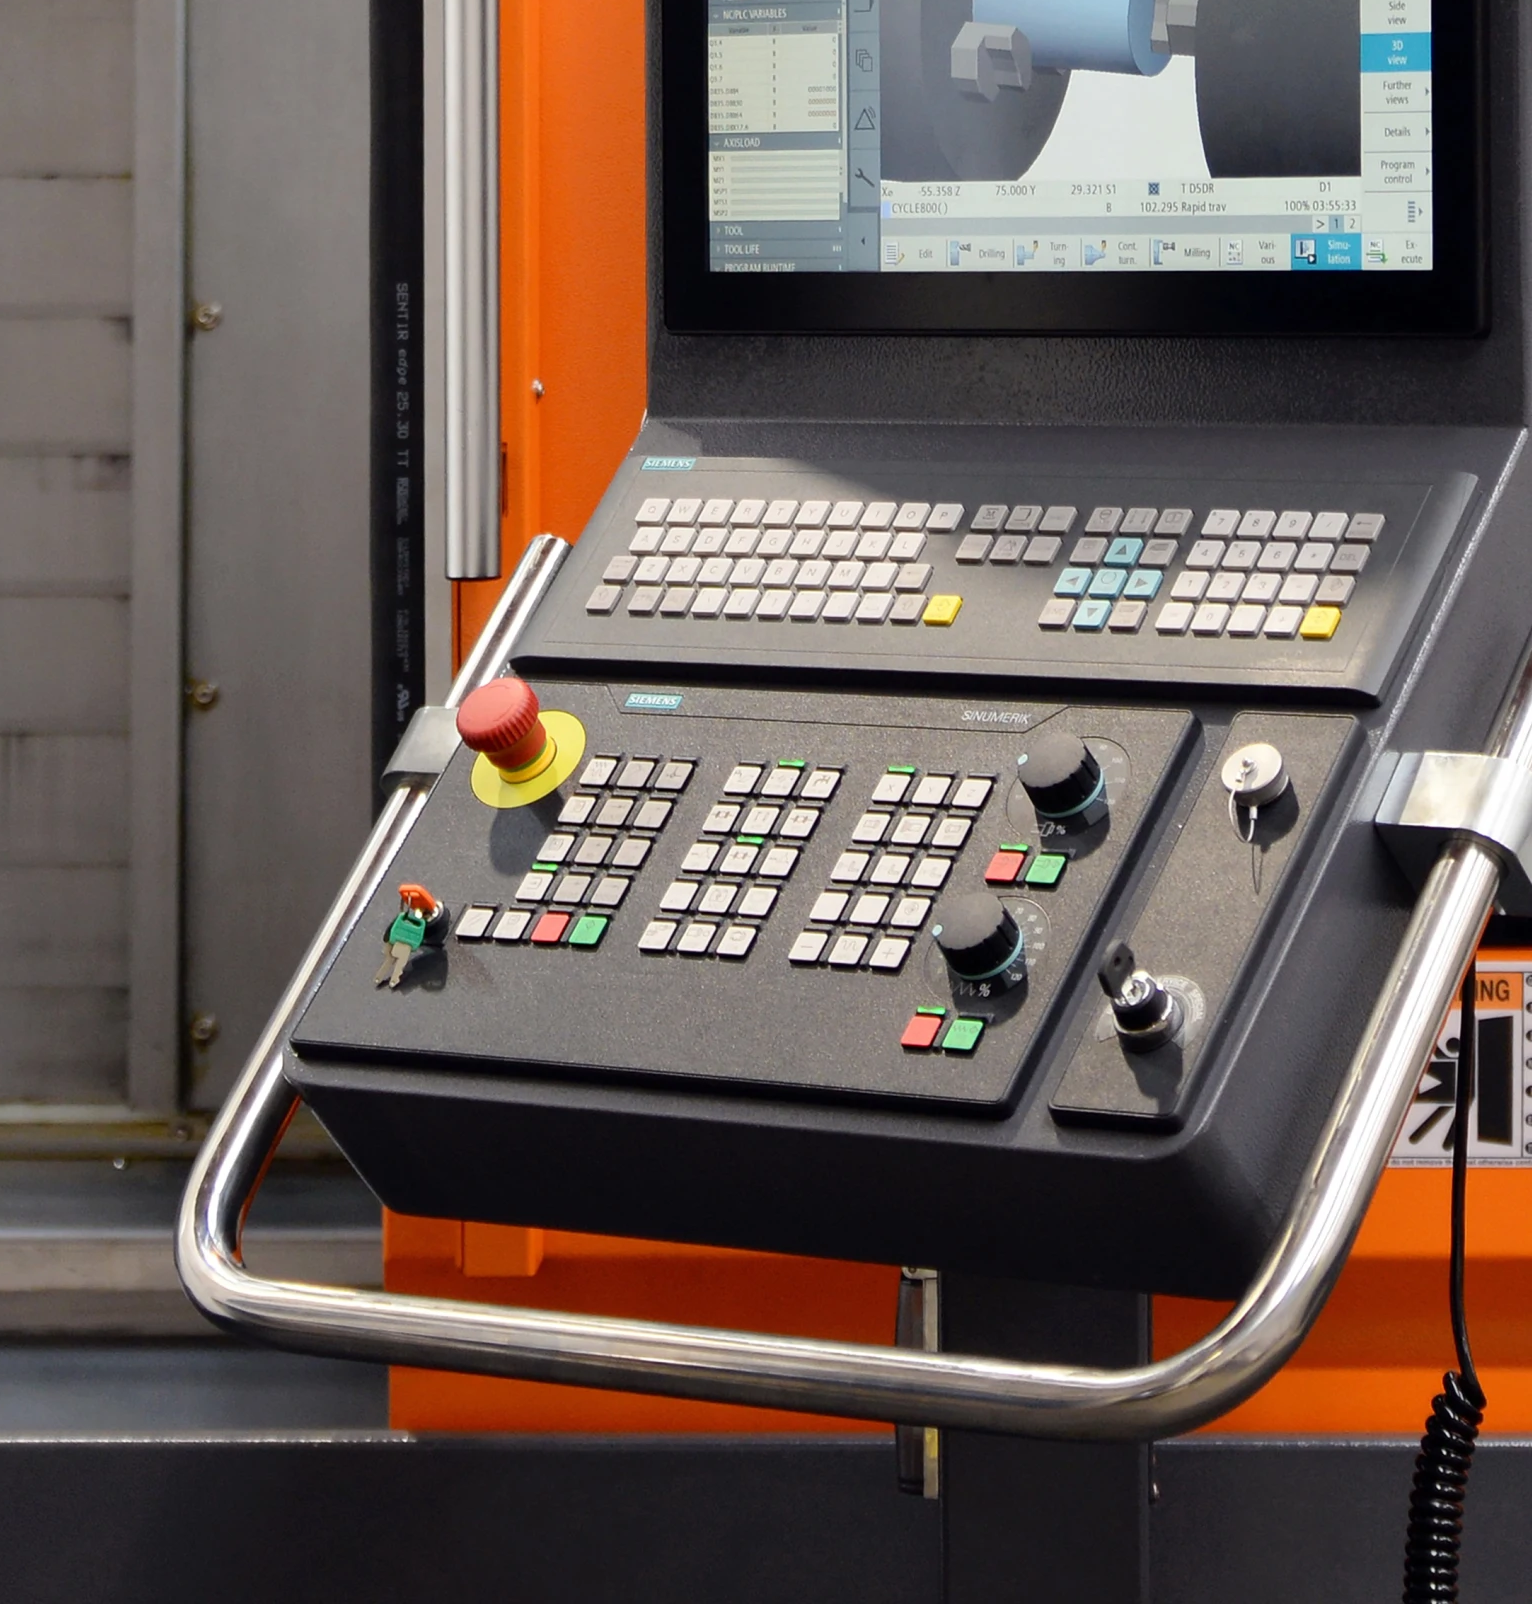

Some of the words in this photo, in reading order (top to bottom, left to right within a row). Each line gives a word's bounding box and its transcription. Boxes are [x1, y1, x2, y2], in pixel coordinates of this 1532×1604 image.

[1389, 1, 1406, 11] Side
[723, 9, 749, 20] NC/PLC
[749, 8, 788, 19] VARIABLES
[1388, 15, 1407, 25] view
[1391, 39, 1404, 51] 3D
[1387, 54, 1408, 65] view
[1383, 80, 1412, 91] Further
[1386, 94, 1409, 105] views
[1384, 127, 1411, 138] Details
[723, 138, 761, 148] AXISLOAD
[1380, 160, 1415, 173] Program
[1384, 174, 1413, 185] control
[954, 185, 961, 196] Z
[995, 185, 1028, 196] 75.000
[1029, 184, 1036, 196] Y
[1071, 184, 1103, 195] 29.321
[1105, 183, 1117, 195] S1
[1181, 183, 1187, 194] T
[1319, 182, 1332, 193] D1
[1106, 202, 1112, 213] B
[1140, 202, 1179, 213] 102.295
[1181, 201, 1205, 215] Rapid
[1206, 202, 1227, 213] trav
[1284, 200, 1310, 212] 100%
[1312, 200, 1357, 212] 03:55:33
[1349, 218, 1356, 229] 2
[724, 226, 744, 236] TOOL
[724, 245, 744, 255] TOOL
[745, 244, 760, 255] LIFE
[1050, 241, 1069, 252] Turn-
[1228, 242, 1241, 251] NC
[1258, 240, 1277, 251] Vari-
[1327, 240, 1351, 251] Simu-
[1370, 241, 1382, 250] NC
[919, 248, 933, 260] Edit
[978, 248, 1006, 262] Drilling
[1184, 247, 1211, 260] Milling
[1053, 255, 1066, 267] ing
[1261, 255, 1276, 265] ous
[1327, 254, 1351, 265] lation
[1401, 254, 1423, 265] ecute
[724, 263, 762, 272] PROGRAM
[396, 390, 409, 439] 25.30
[646, 459, 692, 469] SIEMENS
[628, 696, 677, 705] SIEMENS
[961, 710, 1031, 725] SINUMERIK
